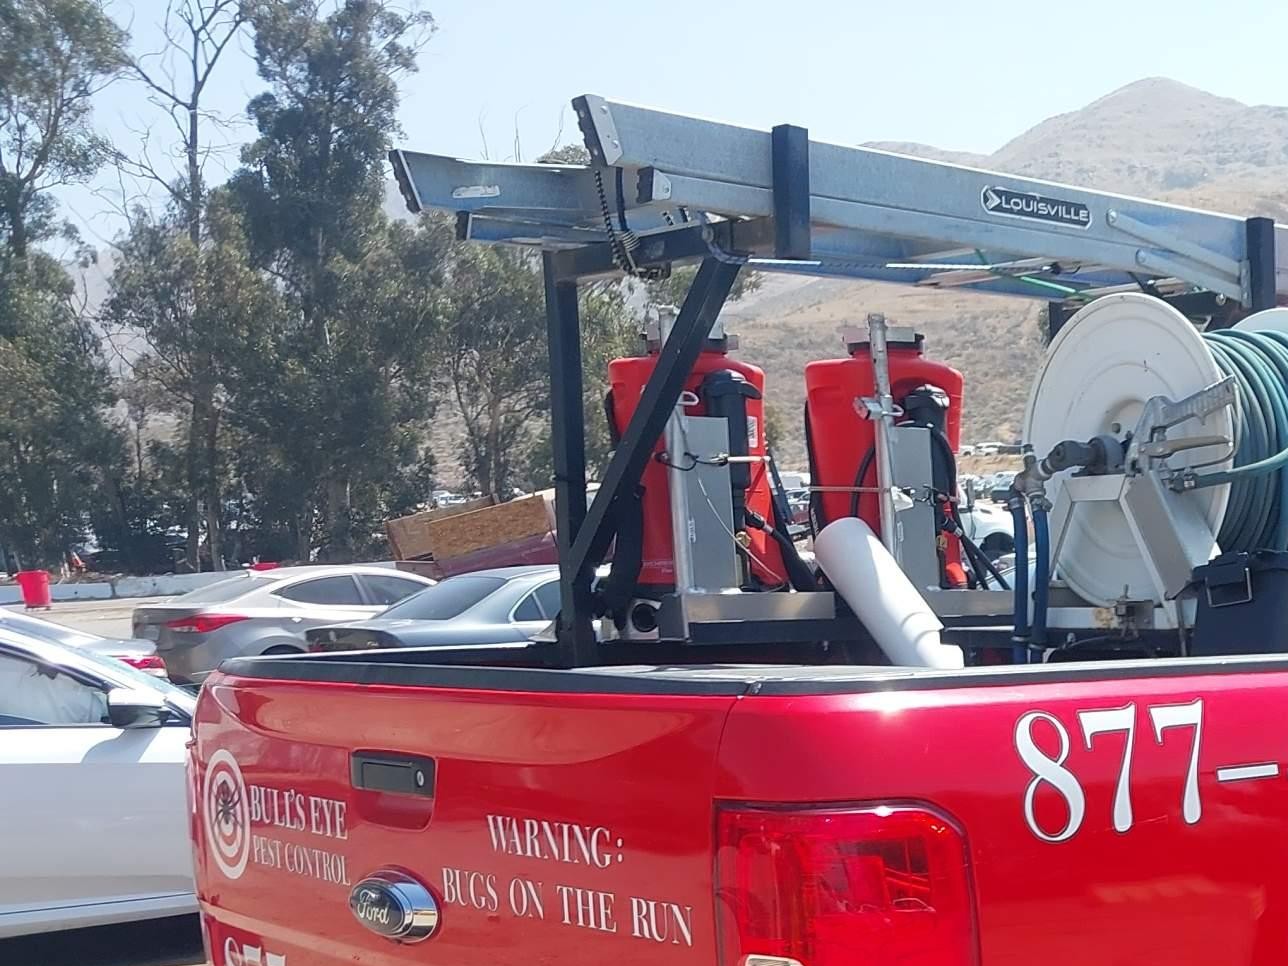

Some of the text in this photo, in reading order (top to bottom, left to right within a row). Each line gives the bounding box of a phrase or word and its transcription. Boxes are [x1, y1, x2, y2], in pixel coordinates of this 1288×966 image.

[1001, 196, 1089, 221] LOUISVILLE
[249, 785, 348, 840] BULL'S EYE
[253, 835, 351, 886] PEST CONTROL
[486, 814, 625, 869] WARNING:
[357, 889, 391, 924] Ford
[441, 867, 693, 947] BUGS ON THE RUN
